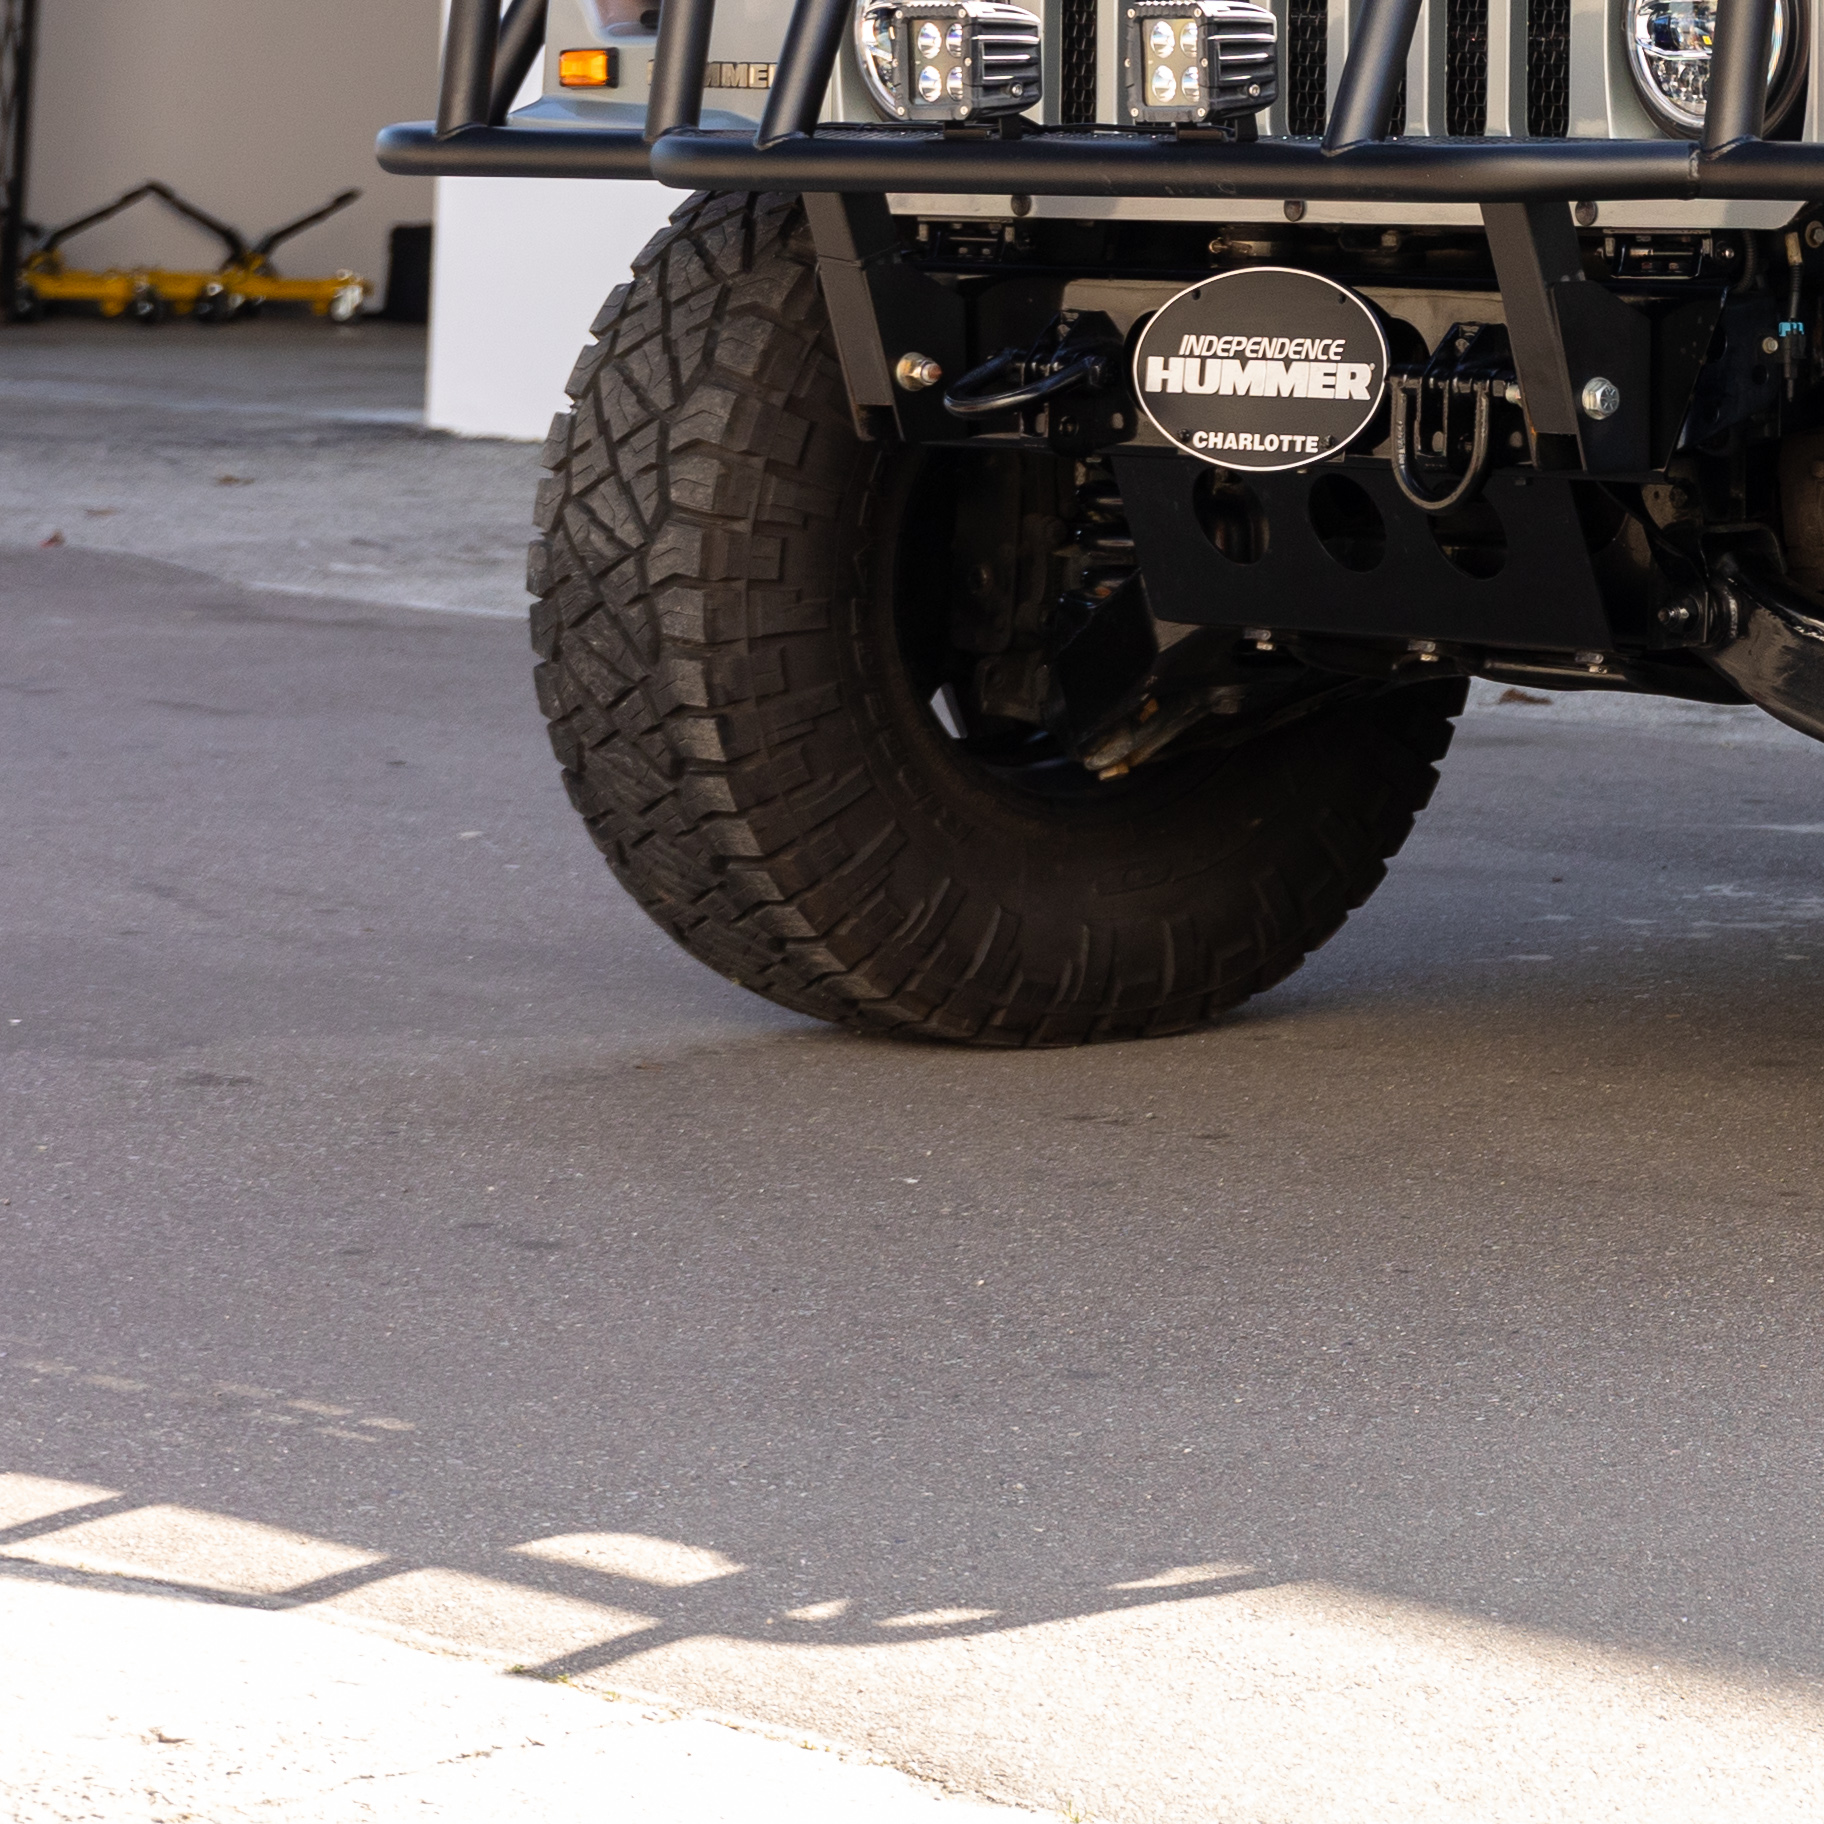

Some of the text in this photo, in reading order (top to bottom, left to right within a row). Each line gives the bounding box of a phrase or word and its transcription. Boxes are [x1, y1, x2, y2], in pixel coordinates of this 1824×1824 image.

[1179, 334, 1346, 361] INDEPENDENCE
[1145, 355, 1372, 401] HUMMER
[1192, 430, 1320, 455] CHARLOTTE
